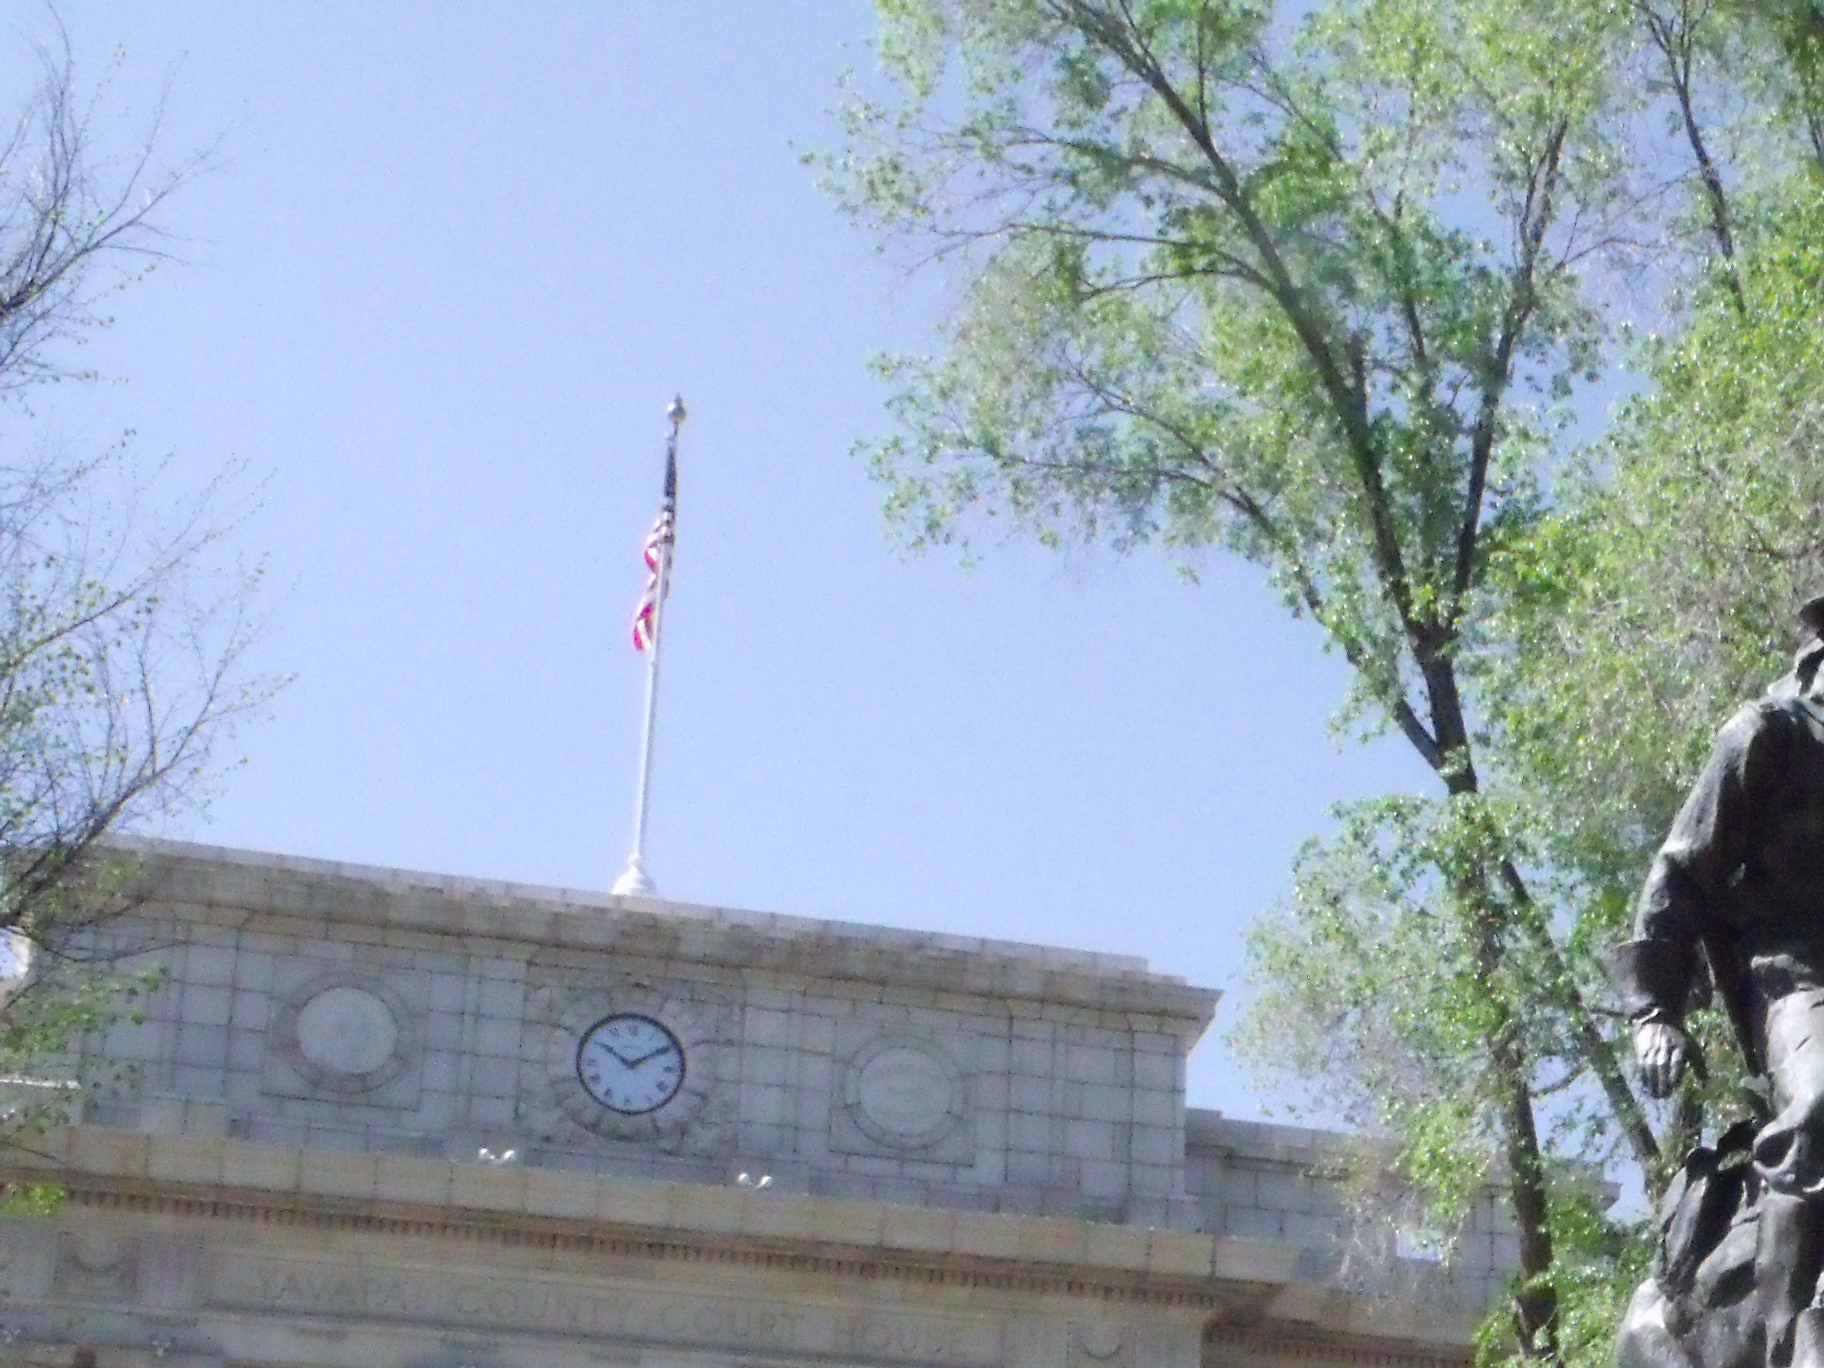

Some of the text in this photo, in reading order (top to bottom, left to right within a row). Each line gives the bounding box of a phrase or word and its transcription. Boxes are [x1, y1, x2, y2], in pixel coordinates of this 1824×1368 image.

[451, 1284, 634, 1324] COUNTY
[660, 1302, 804, 1341] COURT
[832, 1315, 969, 1357] HOUSE
